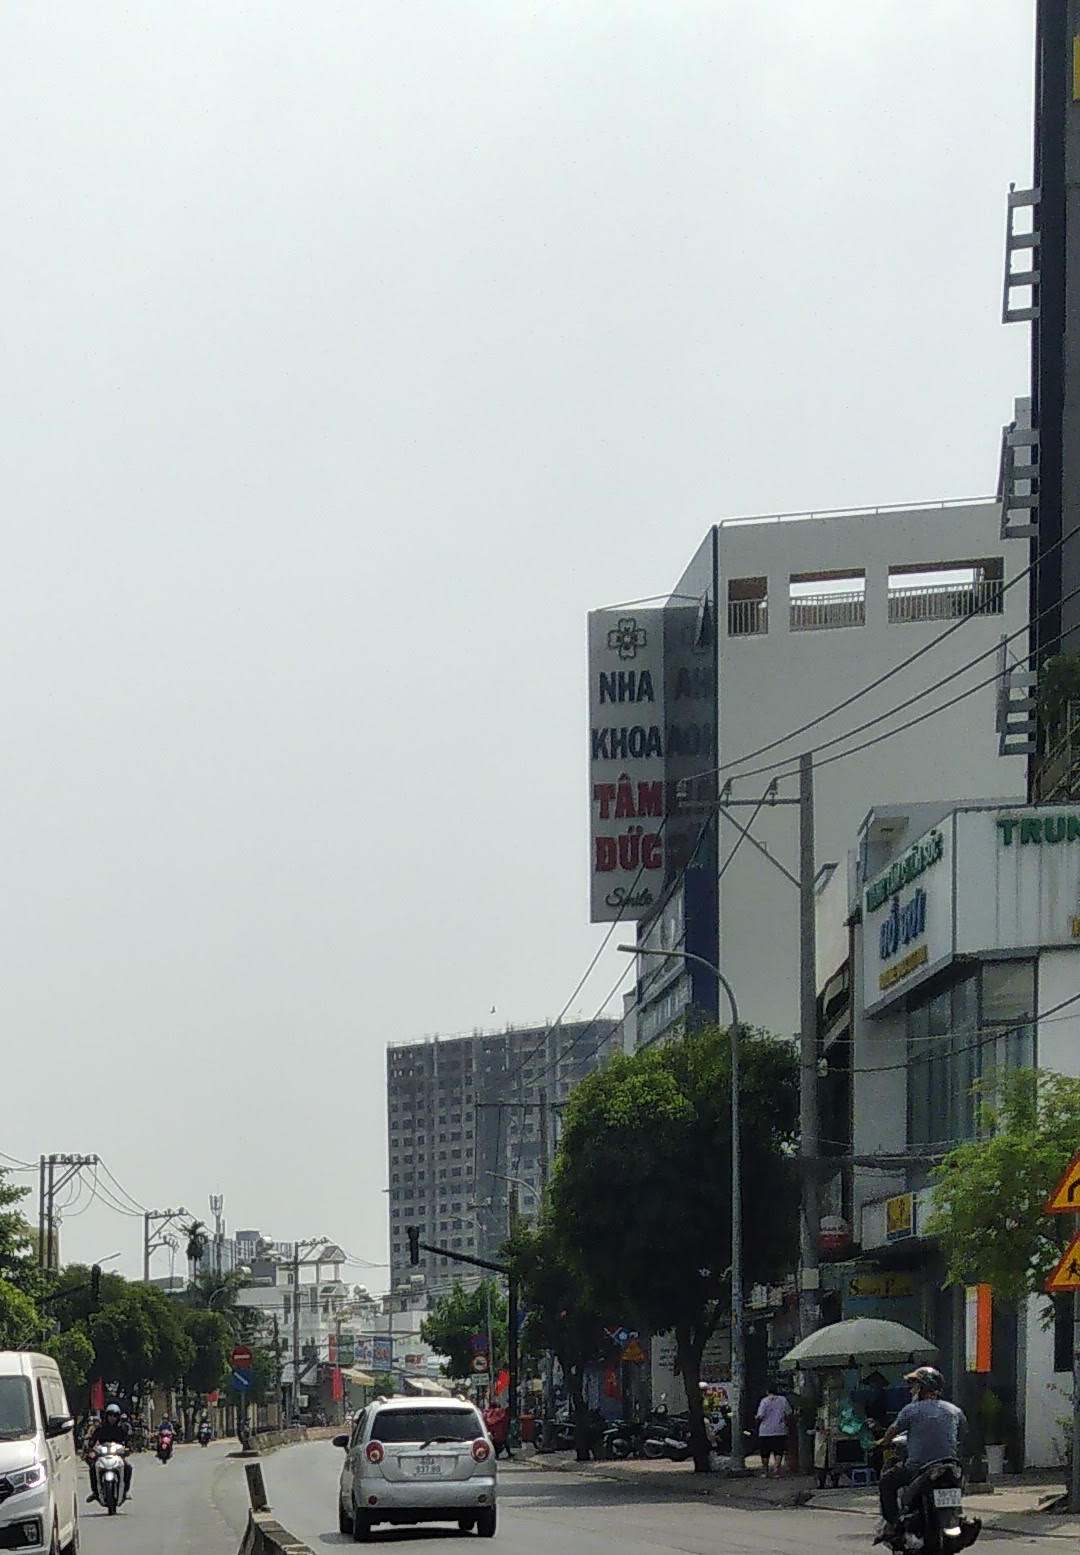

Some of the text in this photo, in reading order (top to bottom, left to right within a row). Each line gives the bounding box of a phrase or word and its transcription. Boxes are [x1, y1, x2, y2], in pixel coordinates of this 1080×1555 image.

[600, 669, 654, 704] NHA
[592, 725, 663, 760] KHOA
[593, 772, 663, 819] TÂM
